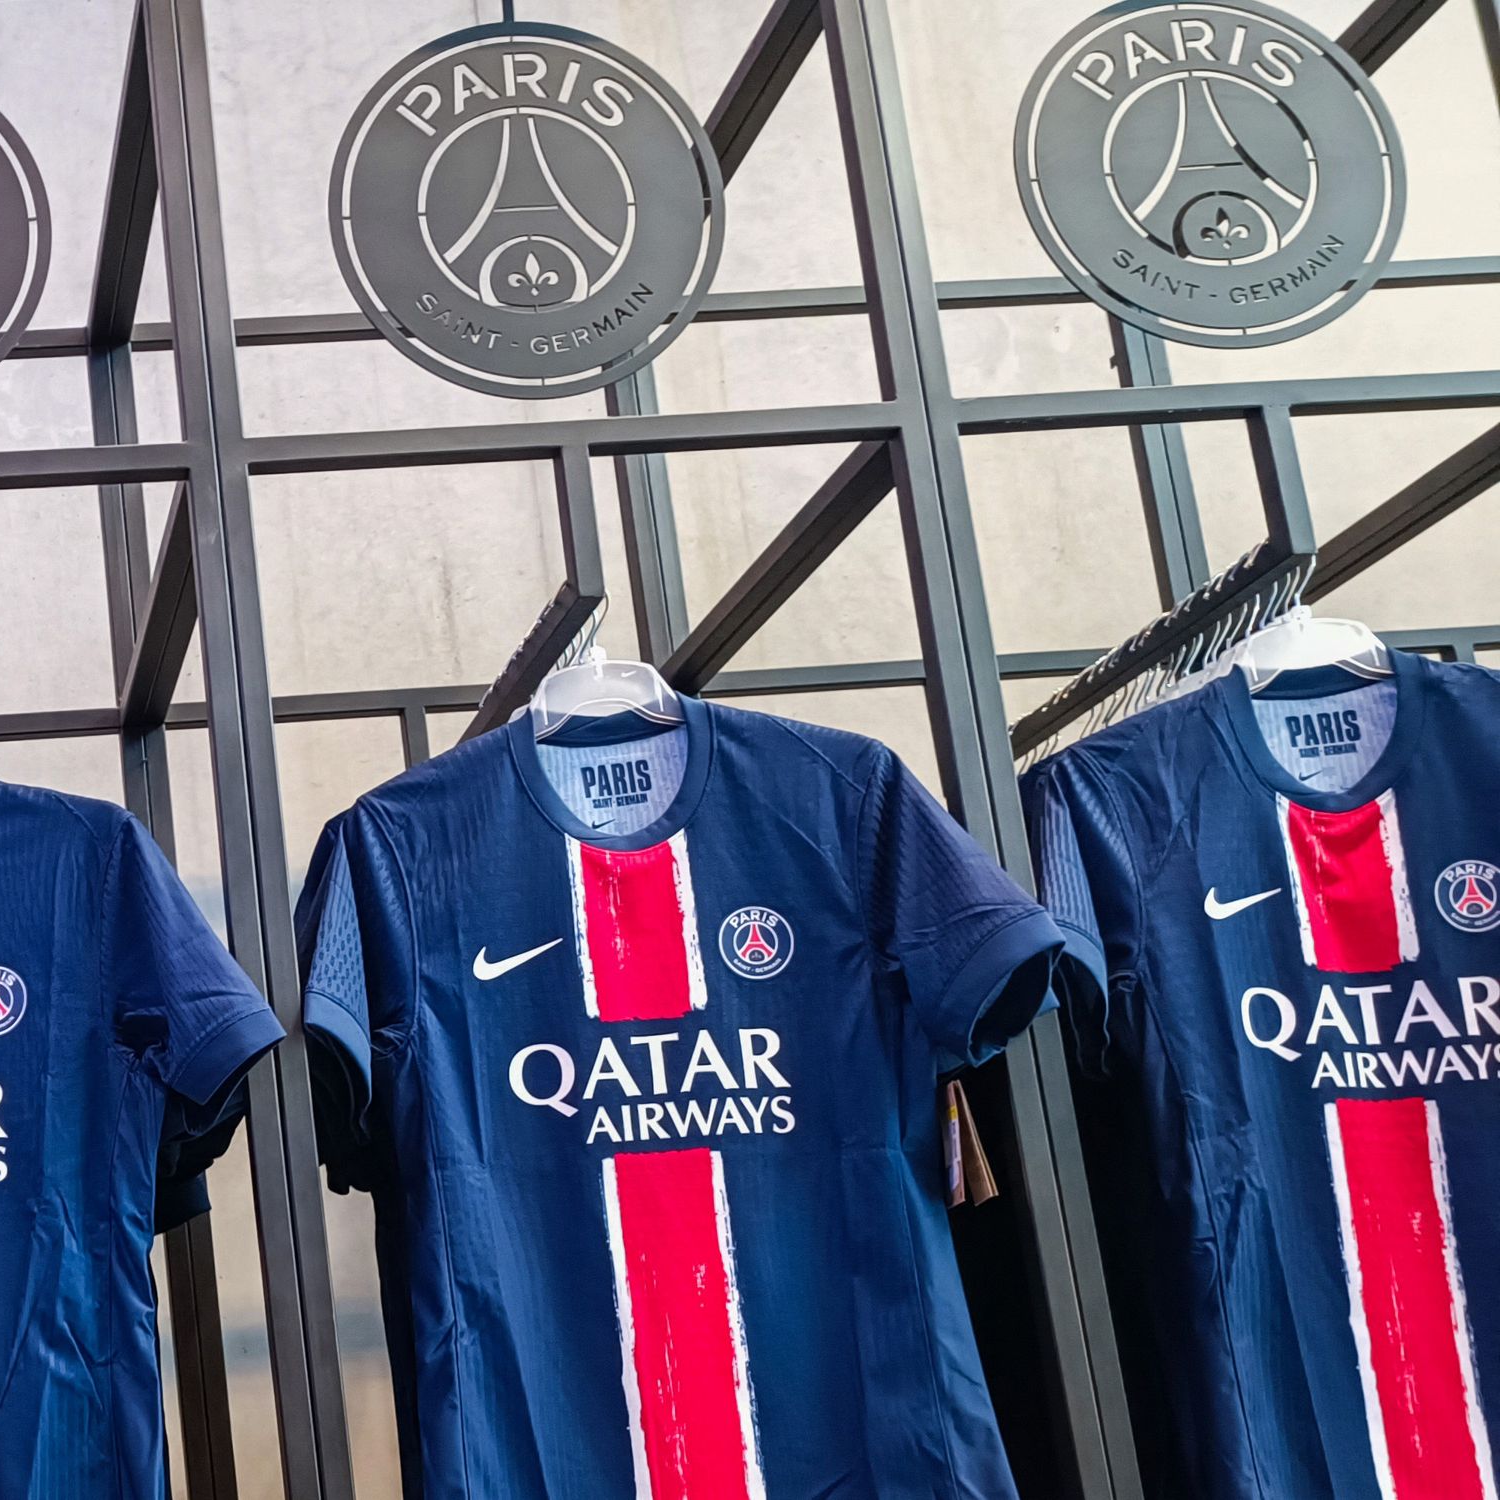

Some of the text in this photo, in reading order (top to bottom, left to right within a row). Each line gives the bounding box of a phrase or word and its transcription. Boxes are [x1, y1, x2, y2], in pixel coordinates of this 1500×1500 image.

[1072, 18, 1303, 100] PARIS
[396, 53, 635, 137] PARIS
[1111, 249, 1200, 299] SAINT
[1229, 234, 1345, 305] GERMAIN
[415, 292, 499, 349] SAINT
[530, 282, 655, 356] GERMAIN
[1285, 710, 1361, 748] PARIS
[580, 759, 652, 798] PARIS
[1444, 863, 1495, 883] PARIS
[729, 910, 779, 928] PARIS
[1241, 976, 1500, 1061] QATAR
[508, 1027, 791, 1117] QATAR
[586, 1095, 796, 1145] AIRWAYS
